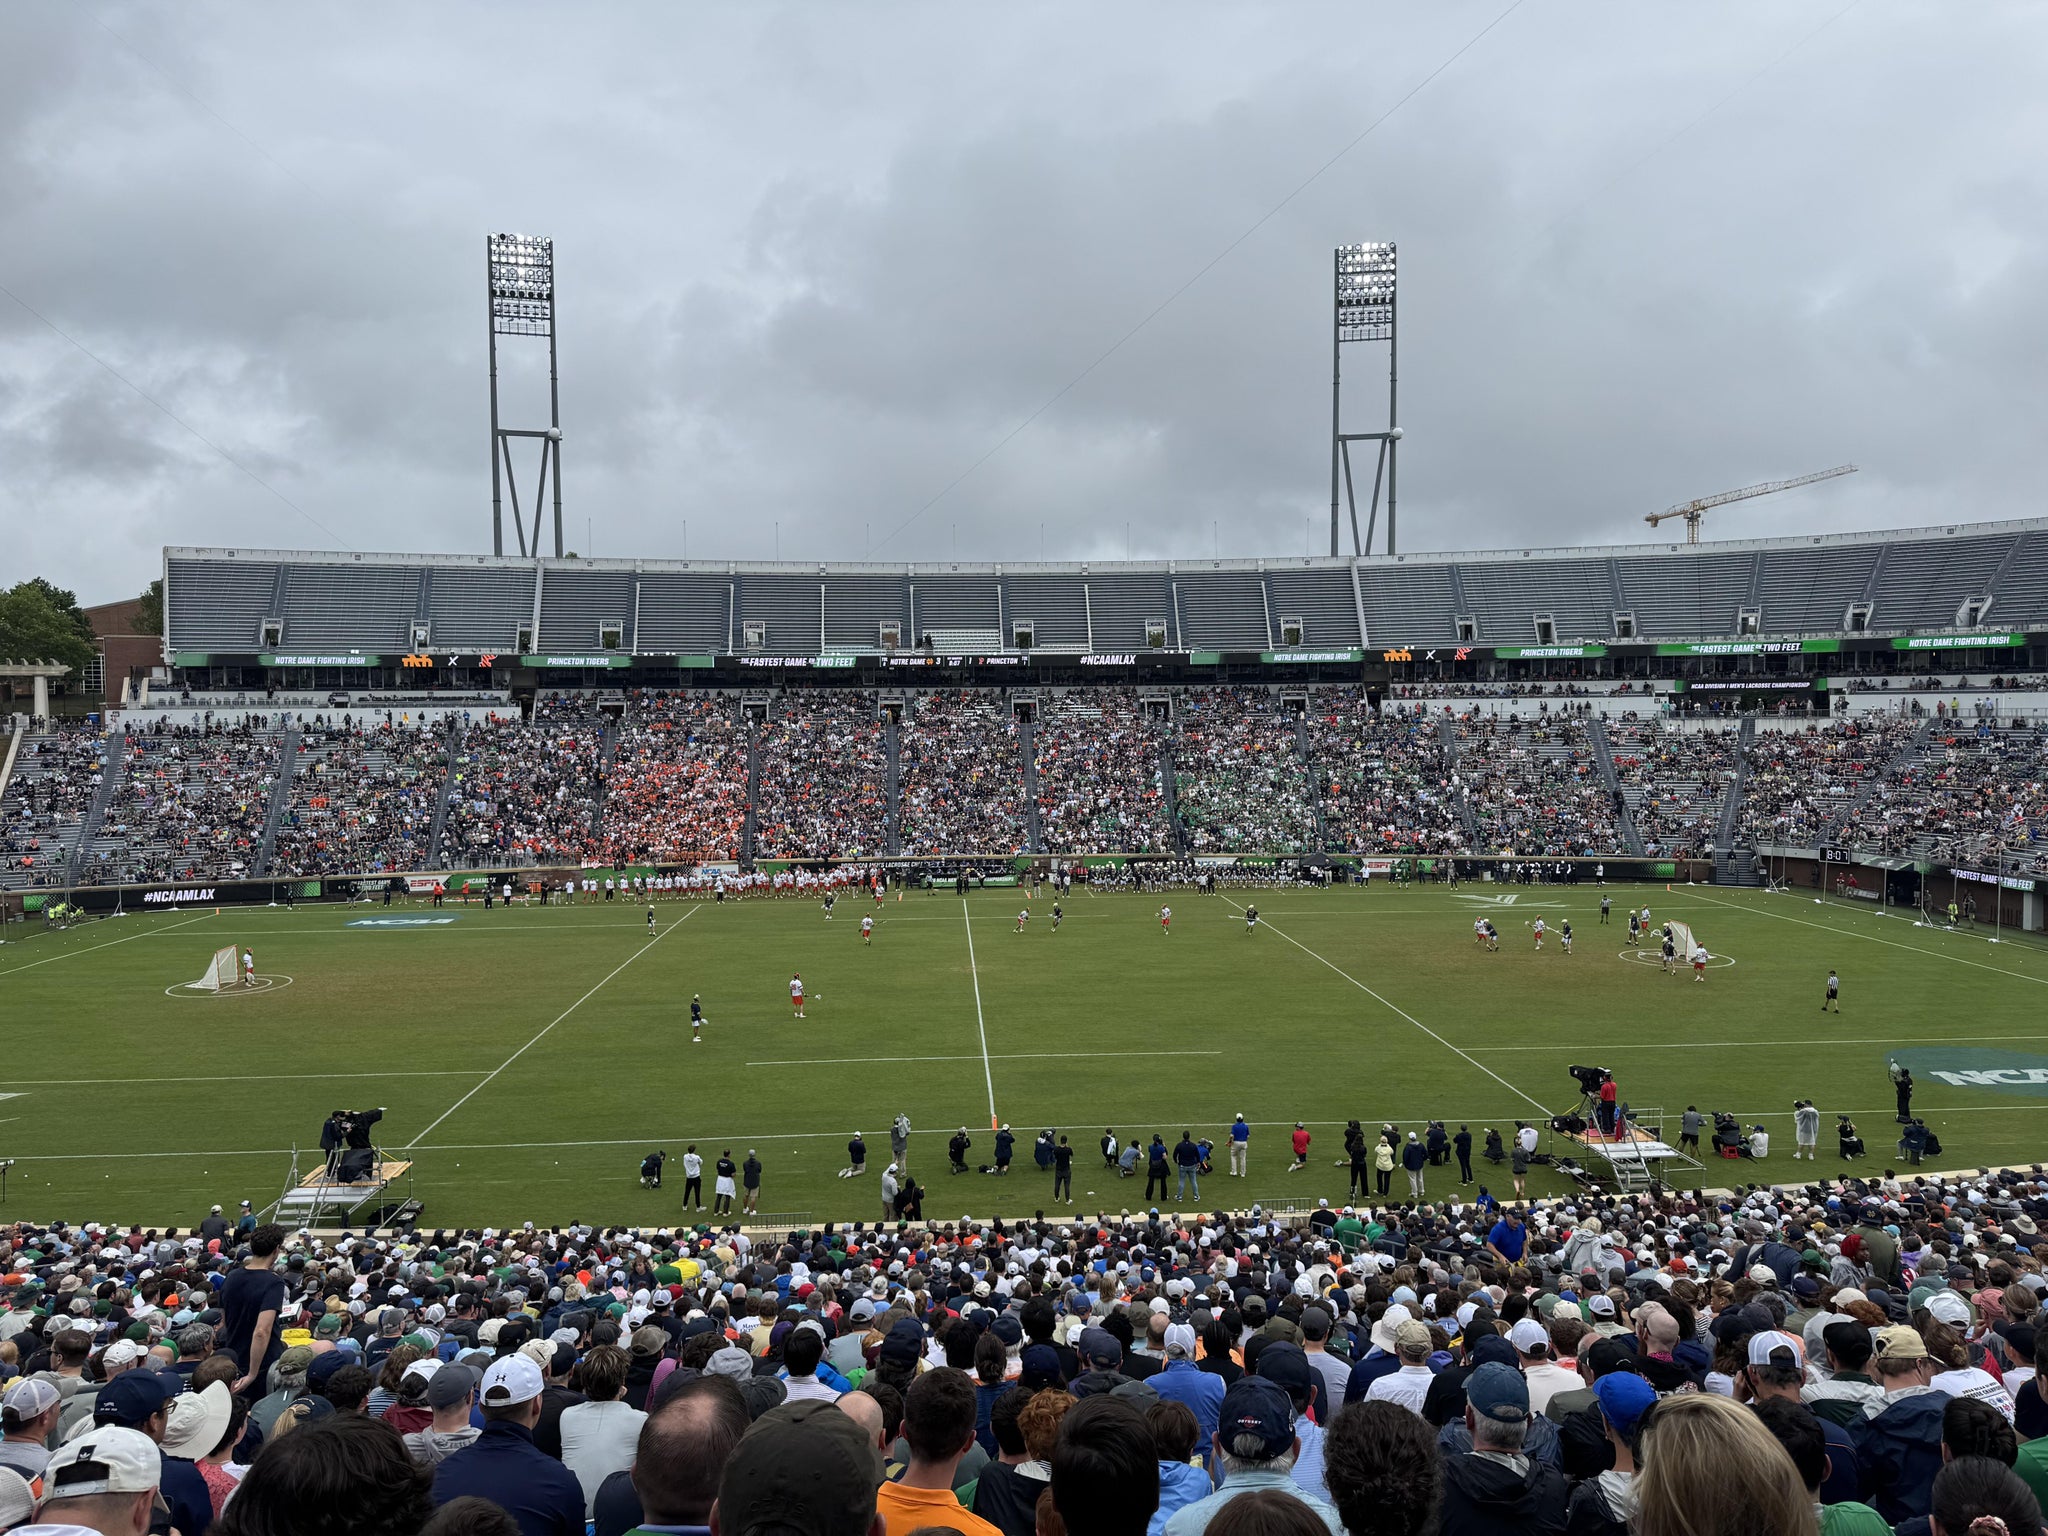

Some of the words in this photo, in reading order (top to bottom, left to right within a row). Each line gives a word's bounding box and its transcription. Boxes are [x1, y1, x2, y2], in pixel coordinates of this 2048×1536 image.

[1908, 639, 1932, 647] NOTRE
[1933, 638, 1953, 647] DAME
[1954, 637, 1987, 646] FIGHTING
[1988, 636, 2010, 645] IRISH
[1520, 648, 1558, 656] PRINCETON
[1559, 647, 1583, 655] TIGERS
[1700, 645, 1731, 653] FASTEST
[1733, 644, 1755, 652] GAME
[1763, 643, 1780, 651] TWO
[1781, 642, 1800, 651] FEET
[275, 656, 298, 665] NOTRE
[298, 656, 316, 665] DAME
[317, 656, 346, 665] FIGHTING
[347, 656, 366, 665] IRISH
[547, 657, 585, 665] PRINCETON
[586, 657, 610, 665] TIGERS
[749, 657, 784, 667] FASTEST
[784, 657, 807, 667] GAME
[816, 657, 834, 667] TWO
[834, 657, 854, 667] FEET
[890, 658, 908, 666] NOTRE
[909, 658, 926, 666] DAME
[935, 657, 941, 665] 3
[986, 657, 1018, 665] PRINCETON
[1080, 655, 1136, 665] #NCAAMLAX
[1309, 653, 1334, 661] FIGHTING
[1826, 850, 1848, 860] 8:07
[1956, 869, 1980, 881] FASTEST
[1980, 873, 1998, 884] GAME
[2004, 877, 2017, 887] TWO
[2017, 879, 2034, 890] FEET
[144, 889, 216, 903] #NCAAMLAX
